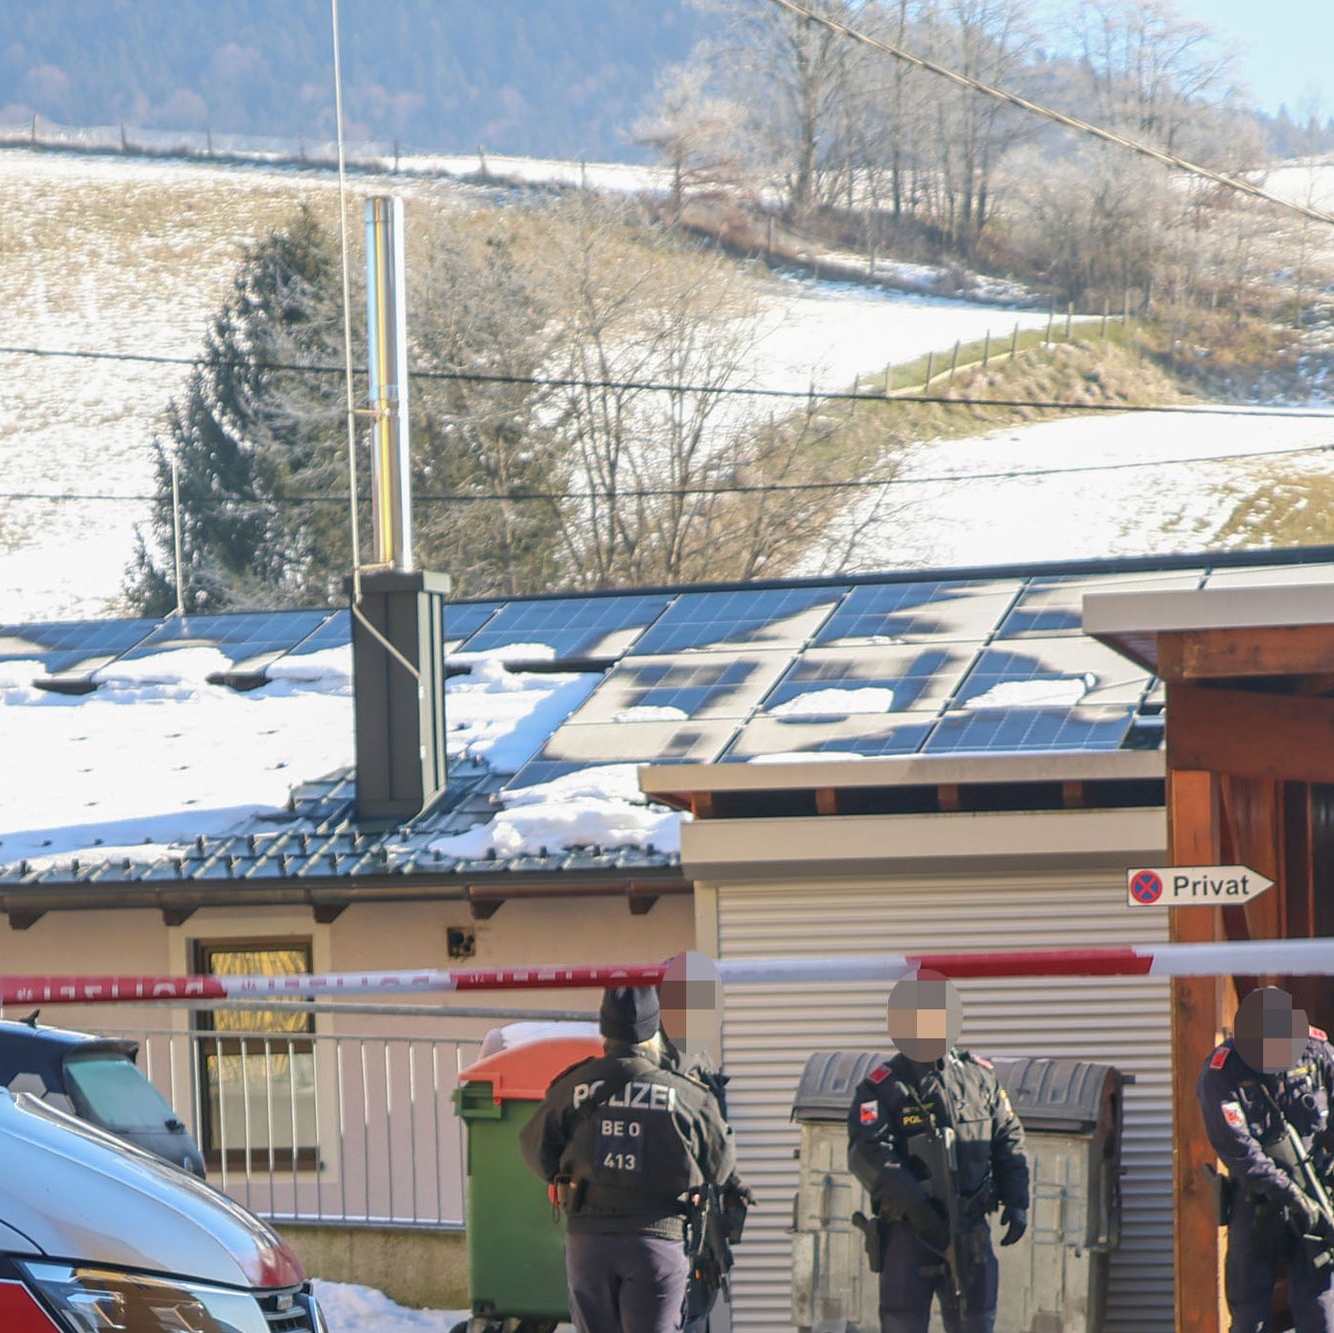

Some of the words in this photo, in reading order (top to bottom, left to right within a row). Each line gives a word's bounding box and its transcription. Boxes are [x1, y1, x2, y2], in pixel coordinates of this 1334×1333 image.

[1174, 875, 1249, 896] Privat
[602, 1120, 624, 1137] BE
[603, 1153, 635, 1170] 413
